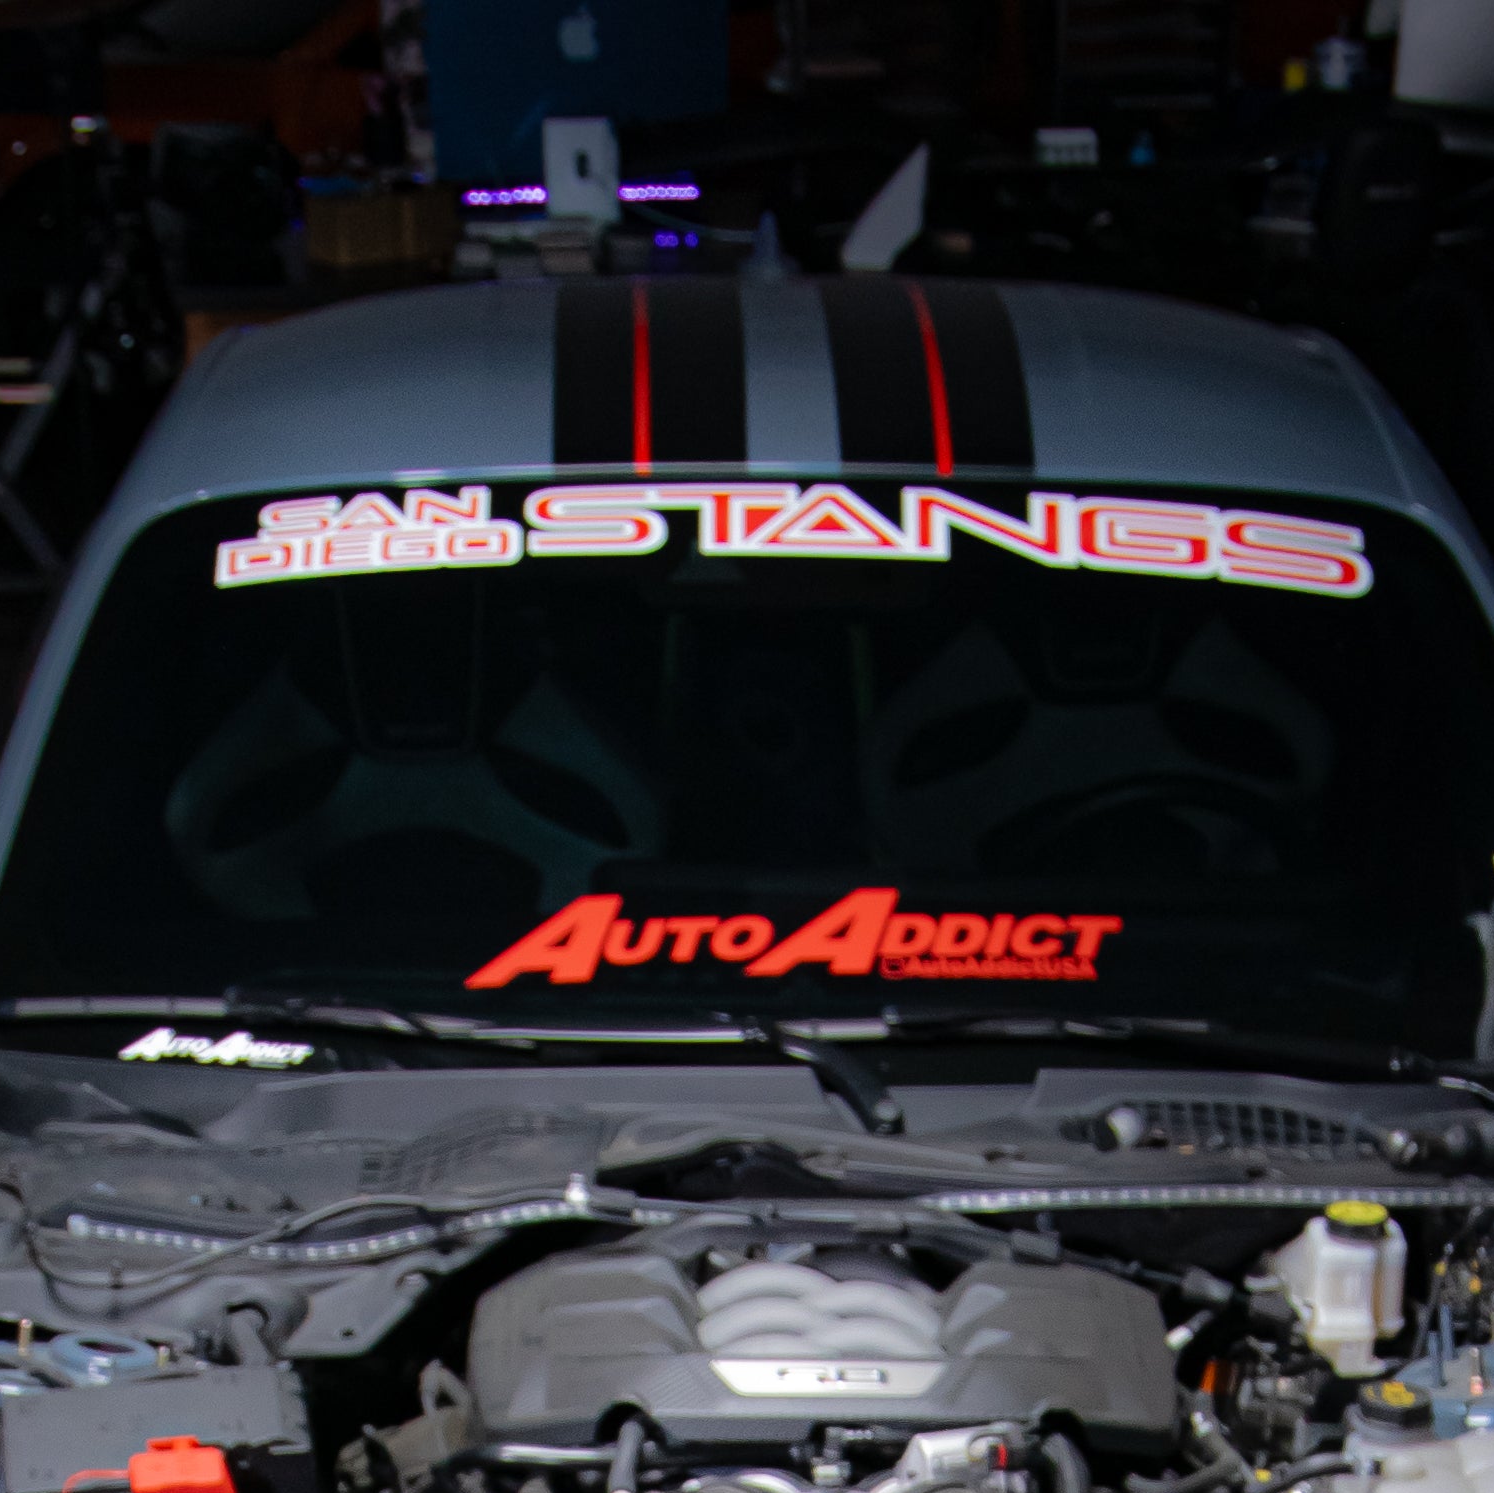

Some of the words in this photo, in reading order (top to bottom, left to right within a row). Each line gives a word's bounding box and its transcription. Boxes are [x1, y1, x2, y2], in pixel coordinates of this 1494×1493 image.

[259, 485, 492, 540] SAN
[525, 483, 1374, 599] STANGS
[214, 519, 525, 589] DIEGO
